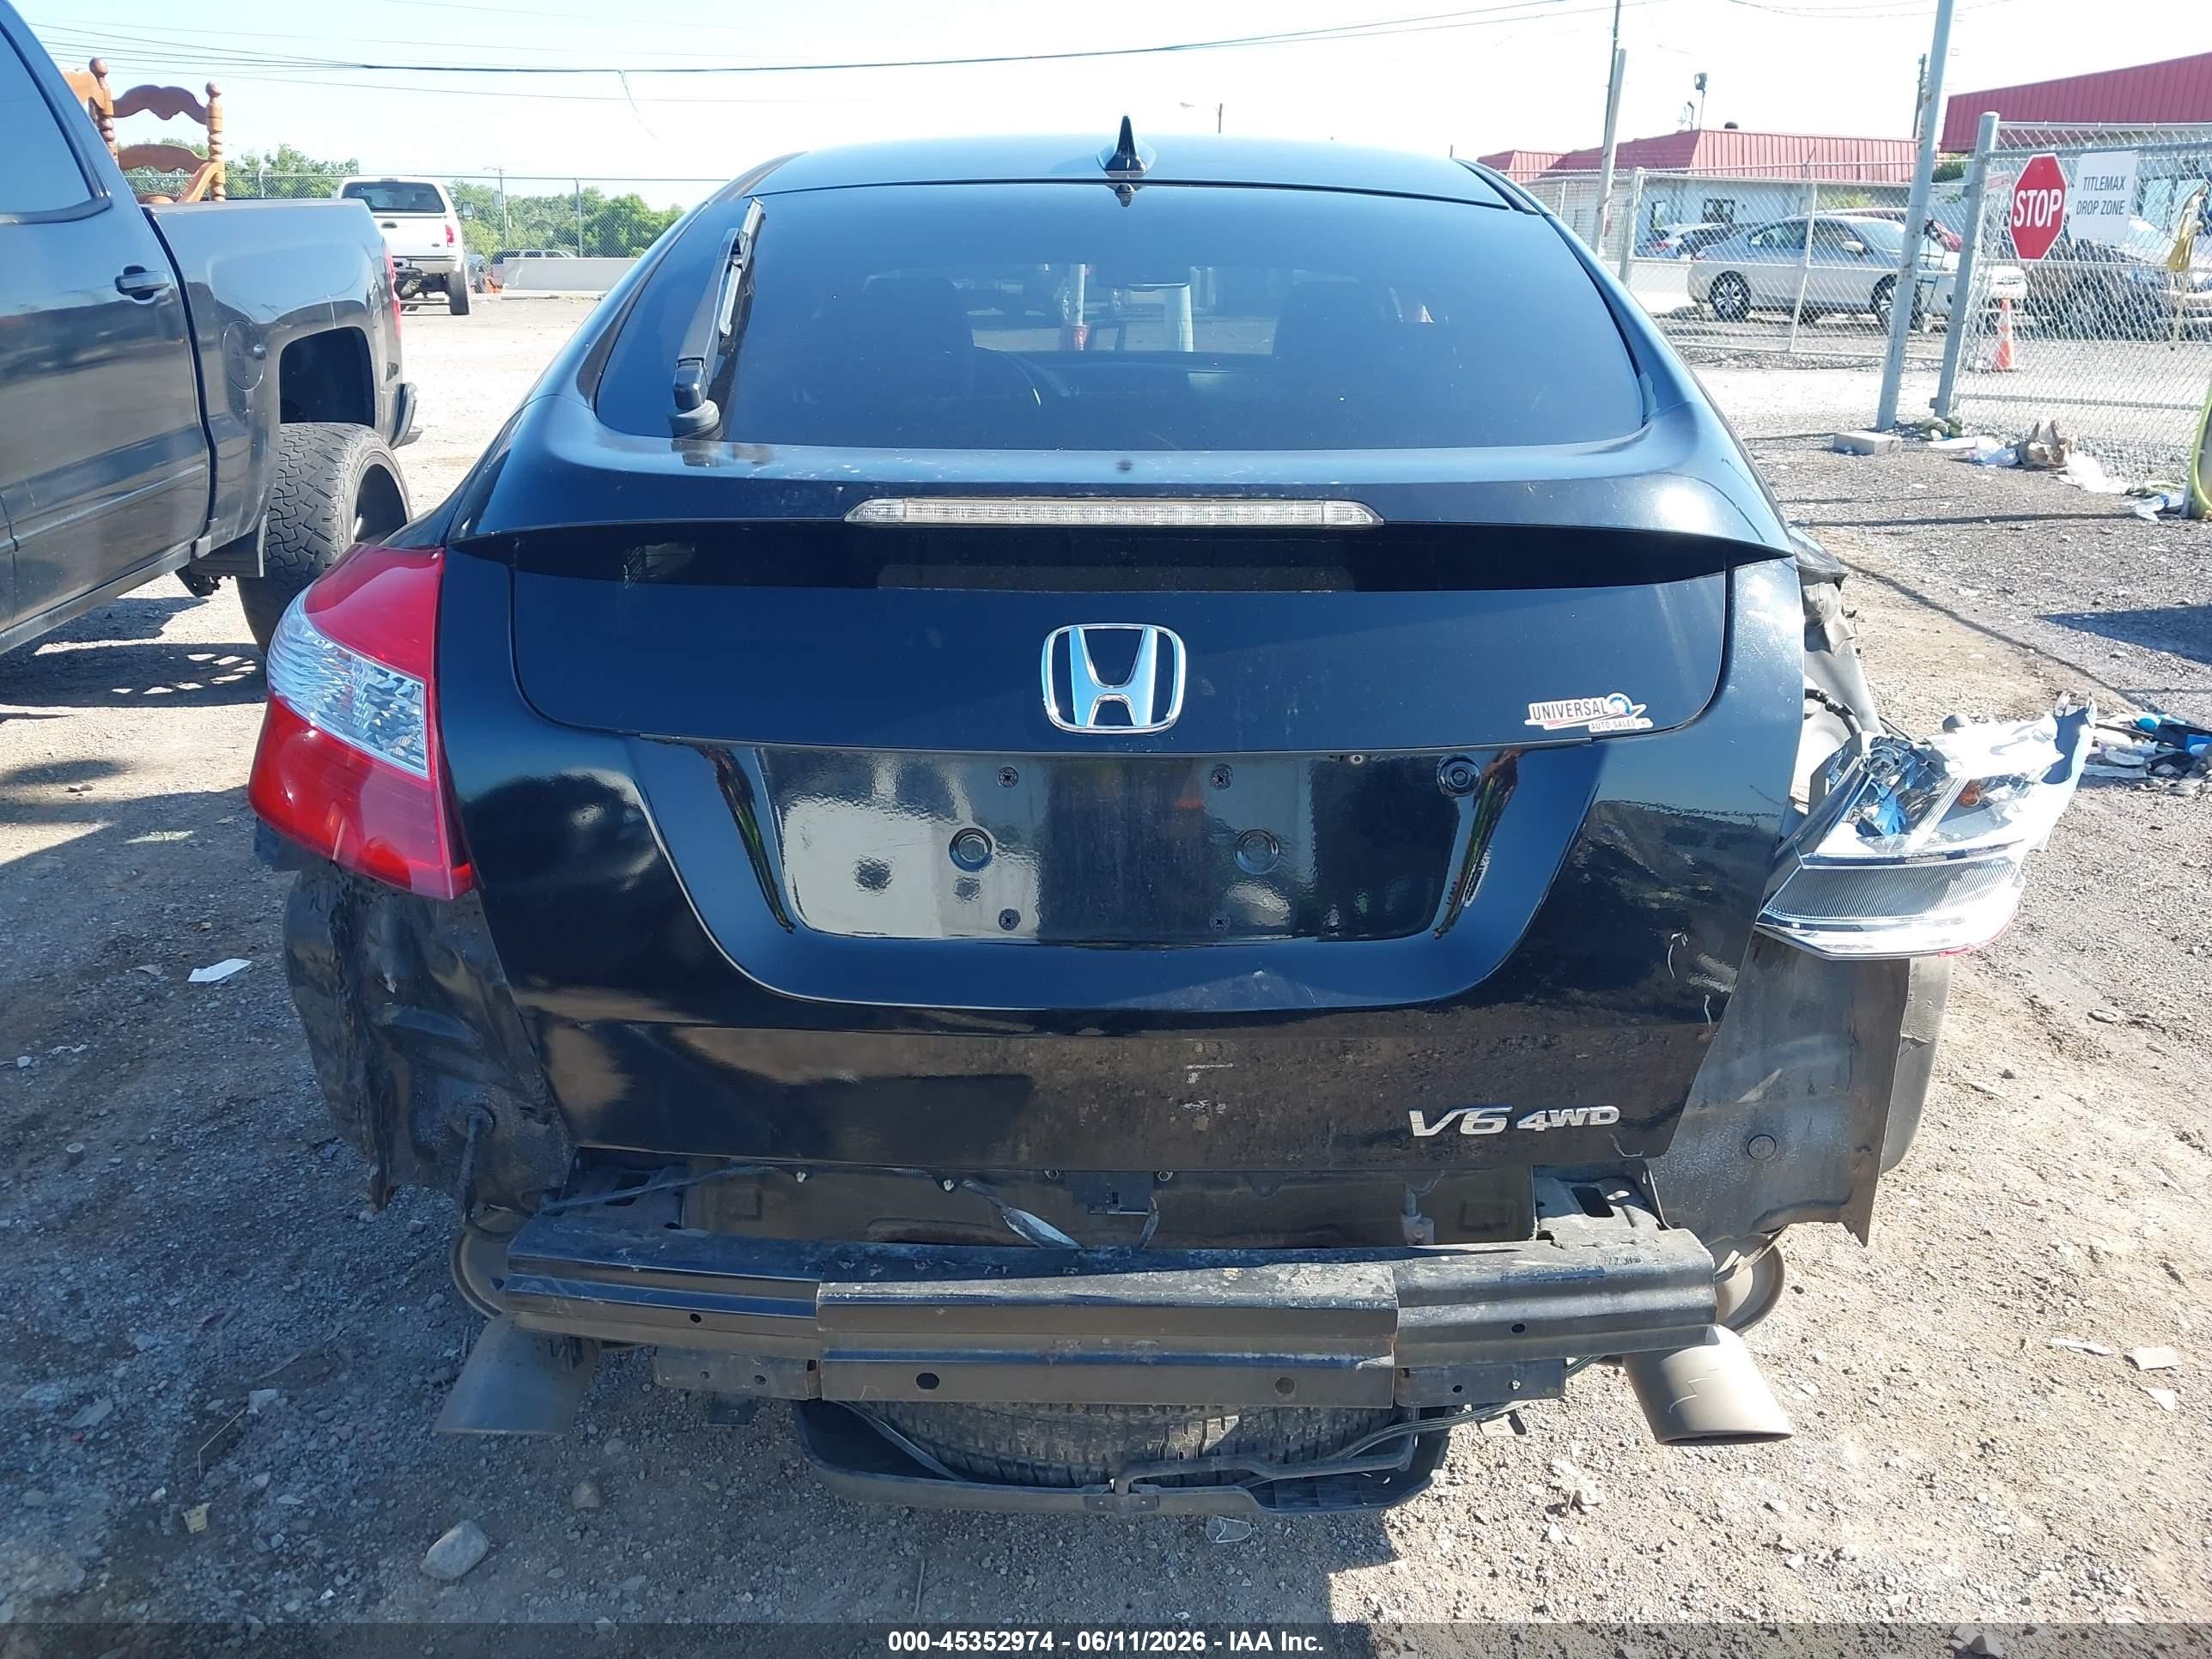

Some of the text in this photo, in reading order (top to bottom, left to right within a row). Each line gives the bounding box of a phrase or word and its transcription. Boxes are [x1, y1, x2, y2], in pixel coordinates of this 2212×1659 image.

[2082, 175, 2127, 191] TITLEMAX
[2014, 189, 2063, 228] STOP
[2076, 200, 2125, 216] DROP ZONE
[1532, 700, 1608, 720] UNIVERSAL
[1591, 721, 1611, 730] AUTO
[1613, 720, 1636, 728] SALES
[1408, 1106, 1620, 1136] V6 4WD
